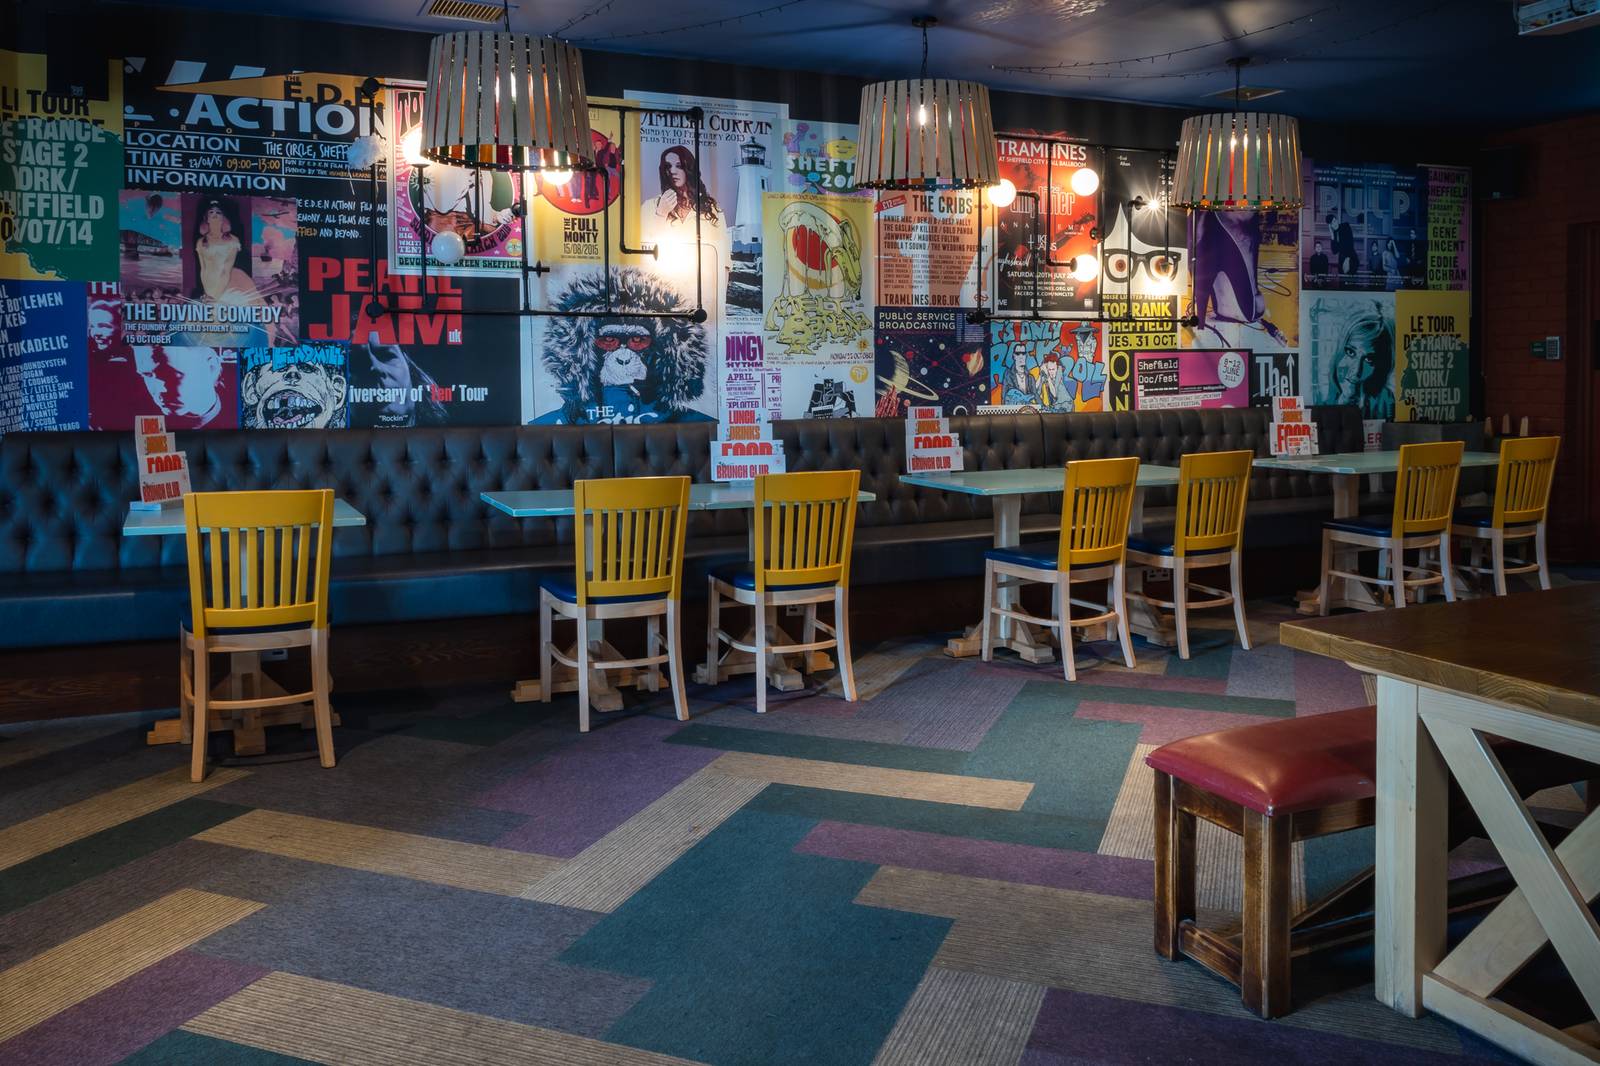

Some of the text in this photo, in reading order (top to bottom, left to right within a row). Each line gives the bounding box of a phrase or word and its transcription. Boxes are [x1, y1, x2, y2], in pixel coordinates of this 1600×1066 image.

[26, 89, 90, 116] TOUR
[684, 129, 724, 141] FERUARY
[126, 131, 240, 152] LOCATION
[263, 141, 283, 155] THE
[680, 138, 717, 147] LISTNERS
[3, 138, 89, 168] SAGE 2
[127, 151, 183, 167] TIME
[128, 169, 286, 191] INFORMATION
[913, 194, 973, 215] THE CRIBS
[325, 215, 337, 224] ALL
[571, 218, 598, 231] FULL
[320, 228, 333, 238] AND
[564, 232, 598, 243] MONTY
[1432, 226, 1457, 239] GENE
[399, 257, 451, 267] DEVOSHIR
[1430, 255, 1459, 268] EDDIE
[884, 293, 960, 306] TRAMLINES.ORG.UK
[125, 303, 282, 323] THE DIVINE COMEDY
[879, 312, 955, 322] PUBLIC SERVICE
[1103, 302, 1128, 318] TOP
[1132, 302, 1172, 317] RANK
[308, 294, 463, 345] JAM
[879, 321, 956, 330] BROADCASTING
[1411, 315, 1455, 333] LE TOUR
[1021, 321, 1063, 341] ONLY
[126, 335, 172, 344] 15 OCTOBER
[1136, 335, 1149, 347] 31
[1153, 334, 1177, 346] OCT.
[8, 336, 69, 358] FUKADELIC
[1138, 360, 1178, 370] Sheffield
[1411, 352, 1454, 369] STAGE 2
[727, 373, 754, 381] APRIL
[1138, 374, 1178, 384] Doc/Fest
[1222, 367, 1240, 377] JUNE
[1416, 370, 1449, 387] YORK/
[350, 385, 407, 405] iversary
[410, 385, 423, 402] of
[458, 385, 488, 402] Tour
[1404, 388, 1461, 406] SHEFFIELD
[727, 400, 759, 409] XPLOITED
[587, 405, 615, 420] THE
[729, 410, 755, 424] LUNCH
[730, 426, 760, 440] DRINKS
[716, 464, 748, 479] BRUNCH
